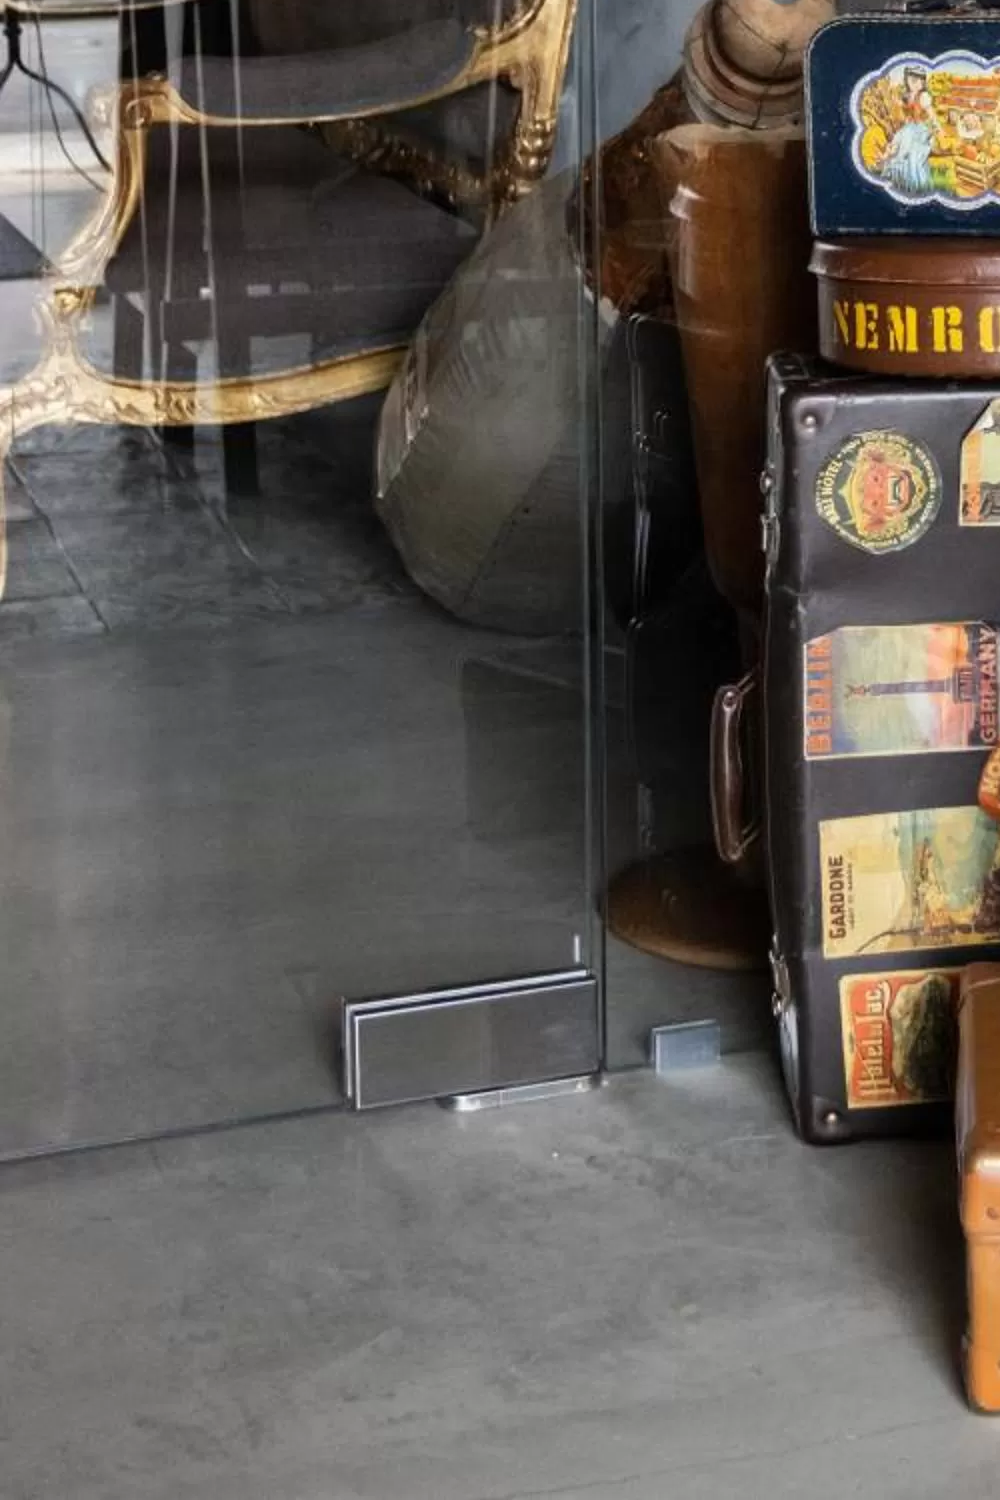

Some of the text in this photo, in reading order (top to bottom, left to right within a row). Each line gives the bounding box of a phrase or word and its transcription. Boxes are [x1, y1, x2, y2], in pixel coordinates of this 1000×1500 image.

[822, 459, 844, 496] HOTEL
[978, 627, 999, 743] GERMANY
[827, 854, 847, 940] GARDONE
